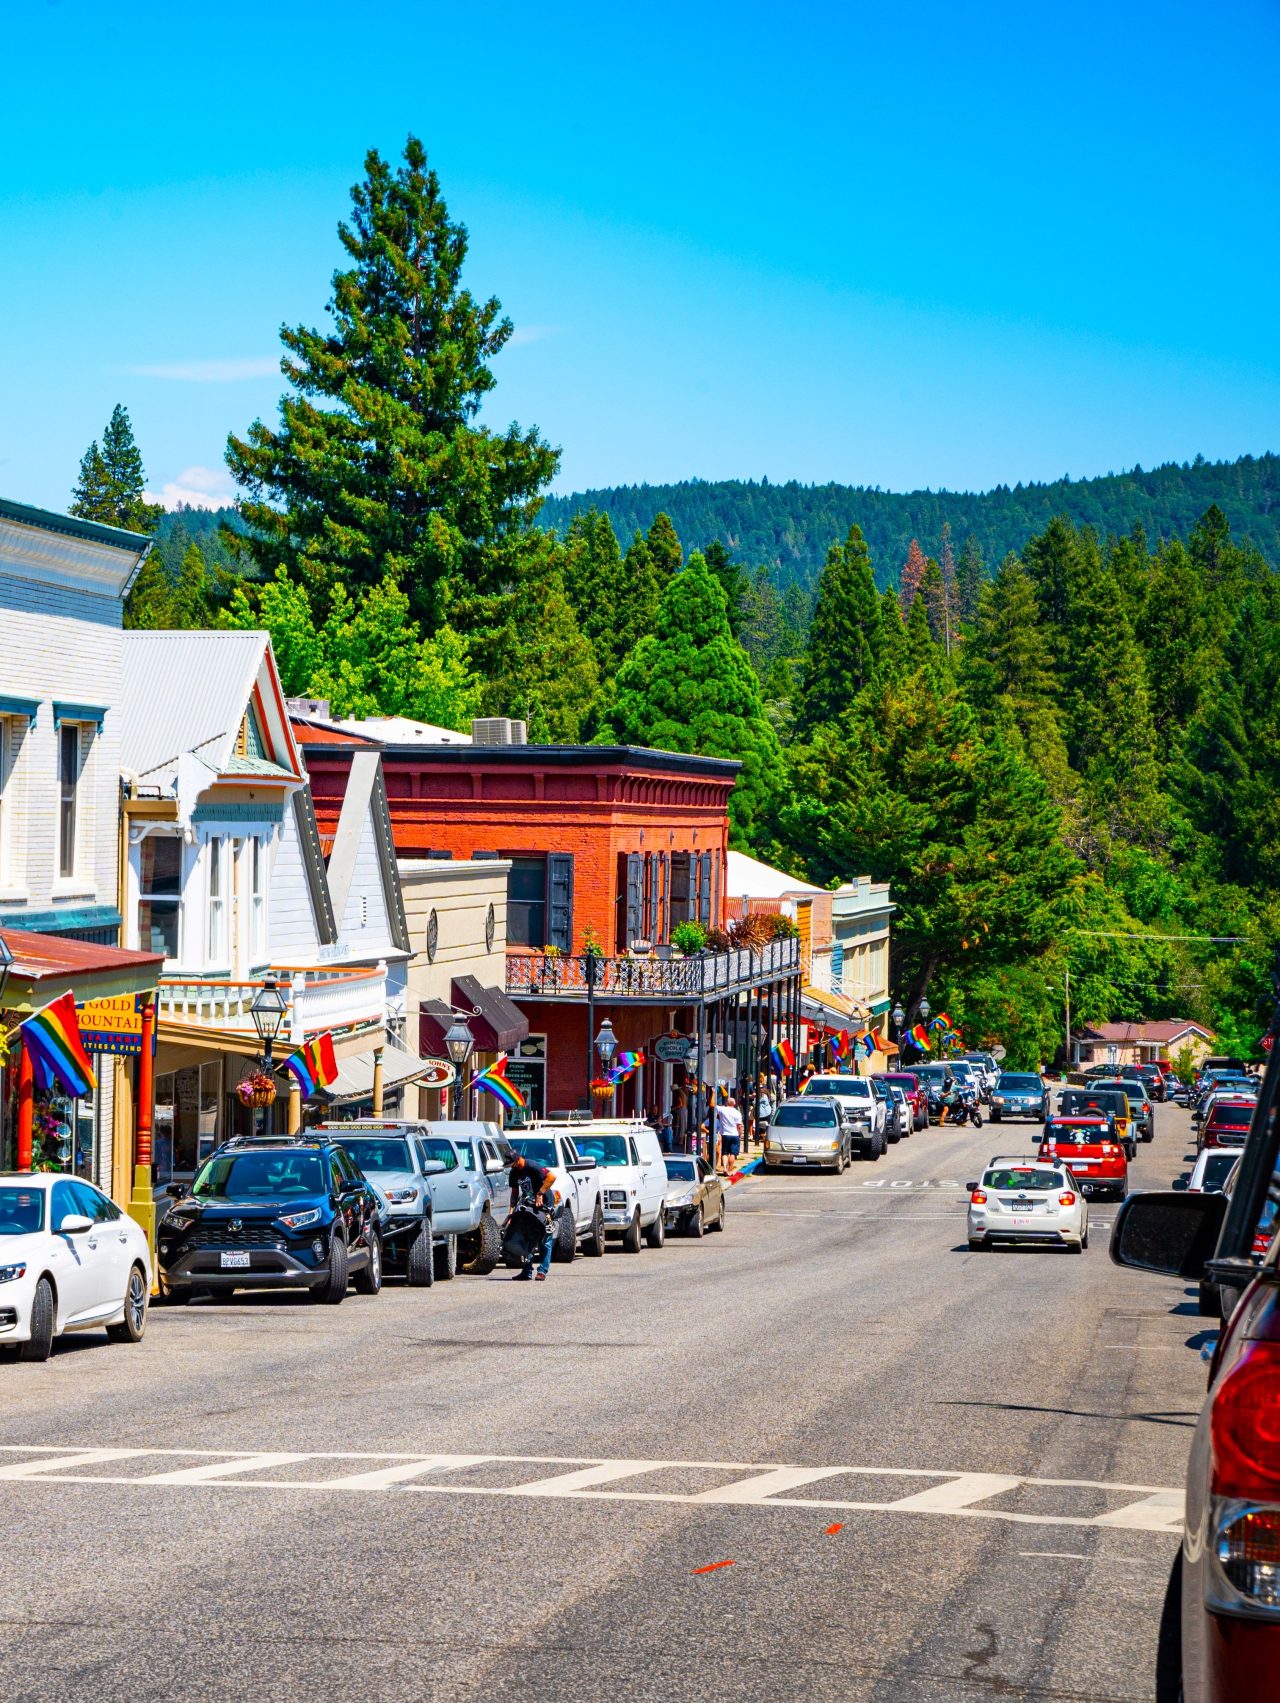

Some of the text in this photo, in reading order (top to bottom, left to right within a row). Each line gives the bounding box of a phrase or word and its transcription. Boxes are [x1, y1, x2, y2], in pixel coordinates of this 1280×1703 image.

[89, 999, 131, 1011] GOLD
[77, 1014, 142, 1029] OUNTAI
[107, 1035, 139, 1043] SHOP
[862, 1179, 959, 1188] STOP
